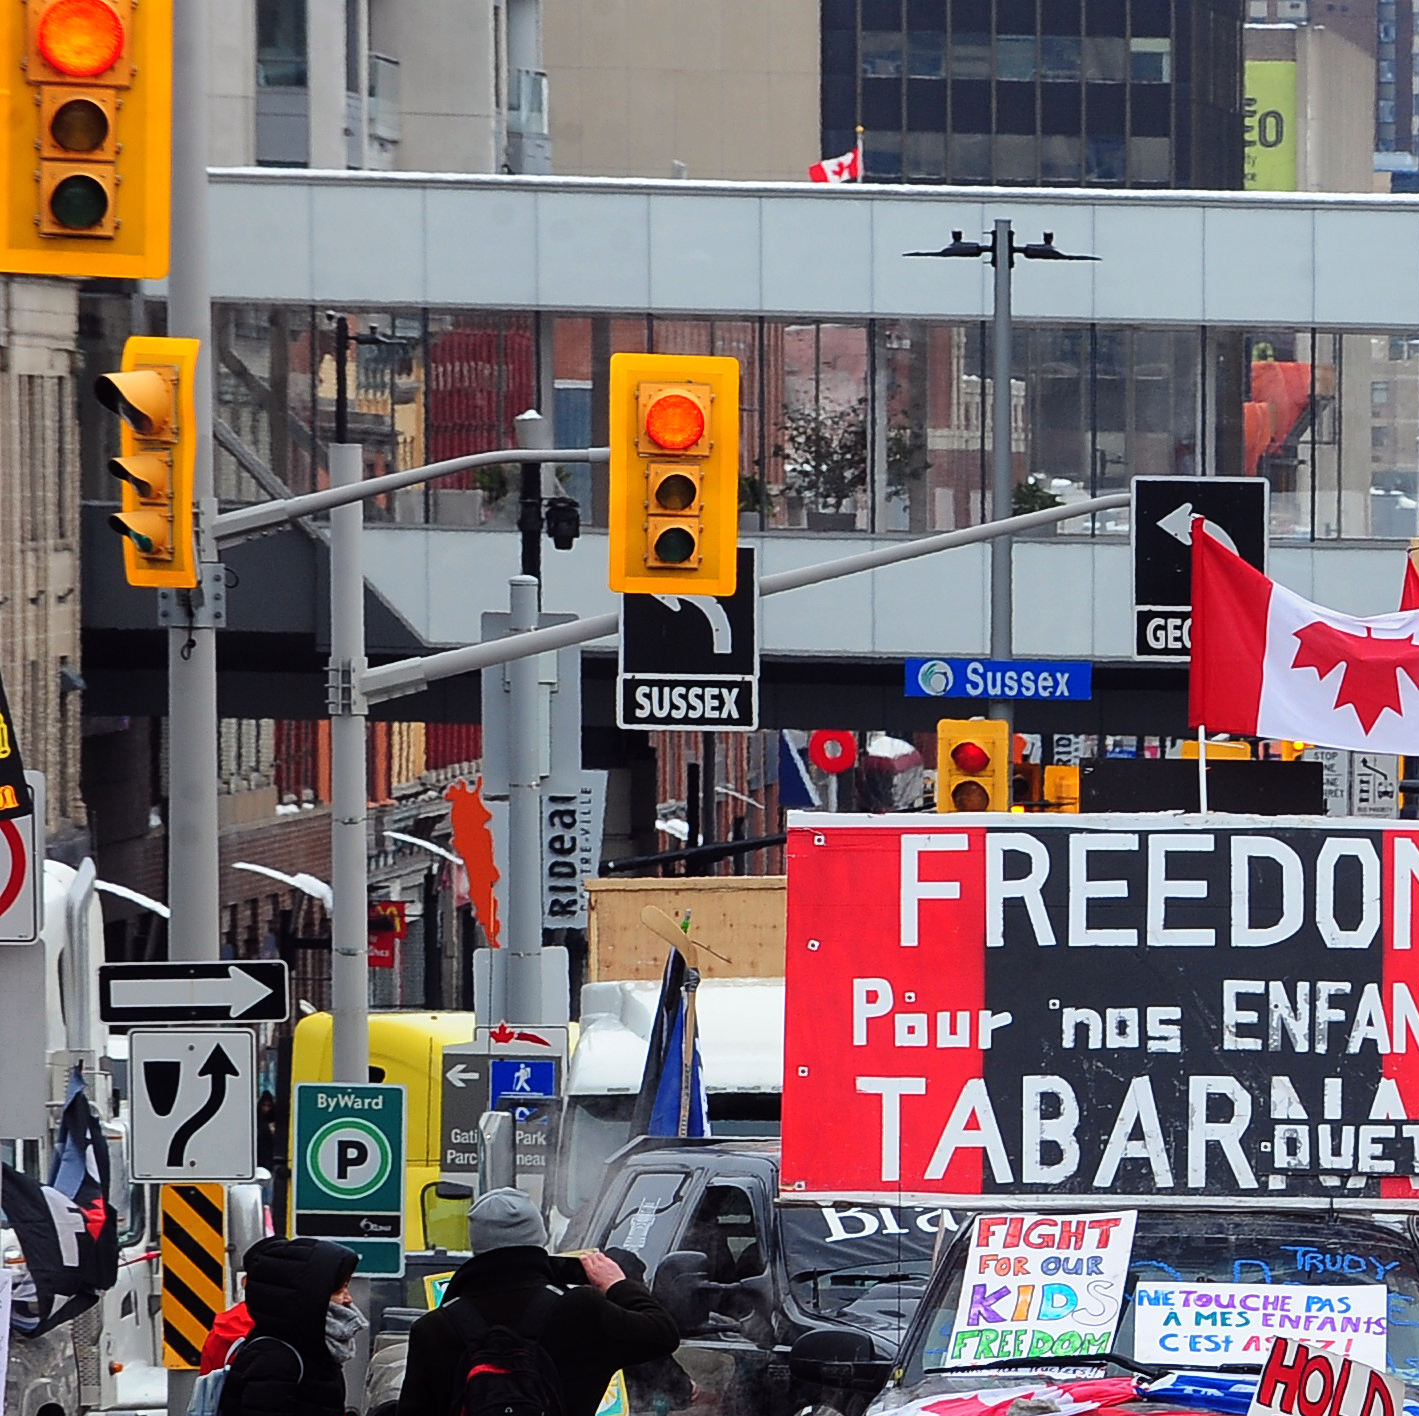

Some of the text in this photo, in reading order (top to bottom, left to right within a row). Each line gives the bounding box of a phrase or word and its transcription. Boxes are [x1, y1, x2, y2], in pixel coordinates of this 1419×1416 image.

[965, 661, 1070, 697] Sussex
[634, 685, 741, 720] SUSSEX
[852, 978, 1013, 1051] Pour
[1061, 1004, 1182, 1054] nos
[317, 1094, 384, 1111] ByWard
[515, 1131, 547, 1145] Park
[336, 1139, 369, 1180] P
[447, 1150, 478, 1165] Parc
[976, 1217, 1122, 1250] FIGHT
[978, 1254, 1105, 1276] FOR OUR
[967, 1280, 1120, 1326] KIDS
[1137, 1289, 1351, 1314] NE TOUCHE PAS
[1162, 1307, 1182, 1327] À
[1194, 1310, 1250, 1328] MES
[951, 1328, 1112, 1360] FREEDOM
